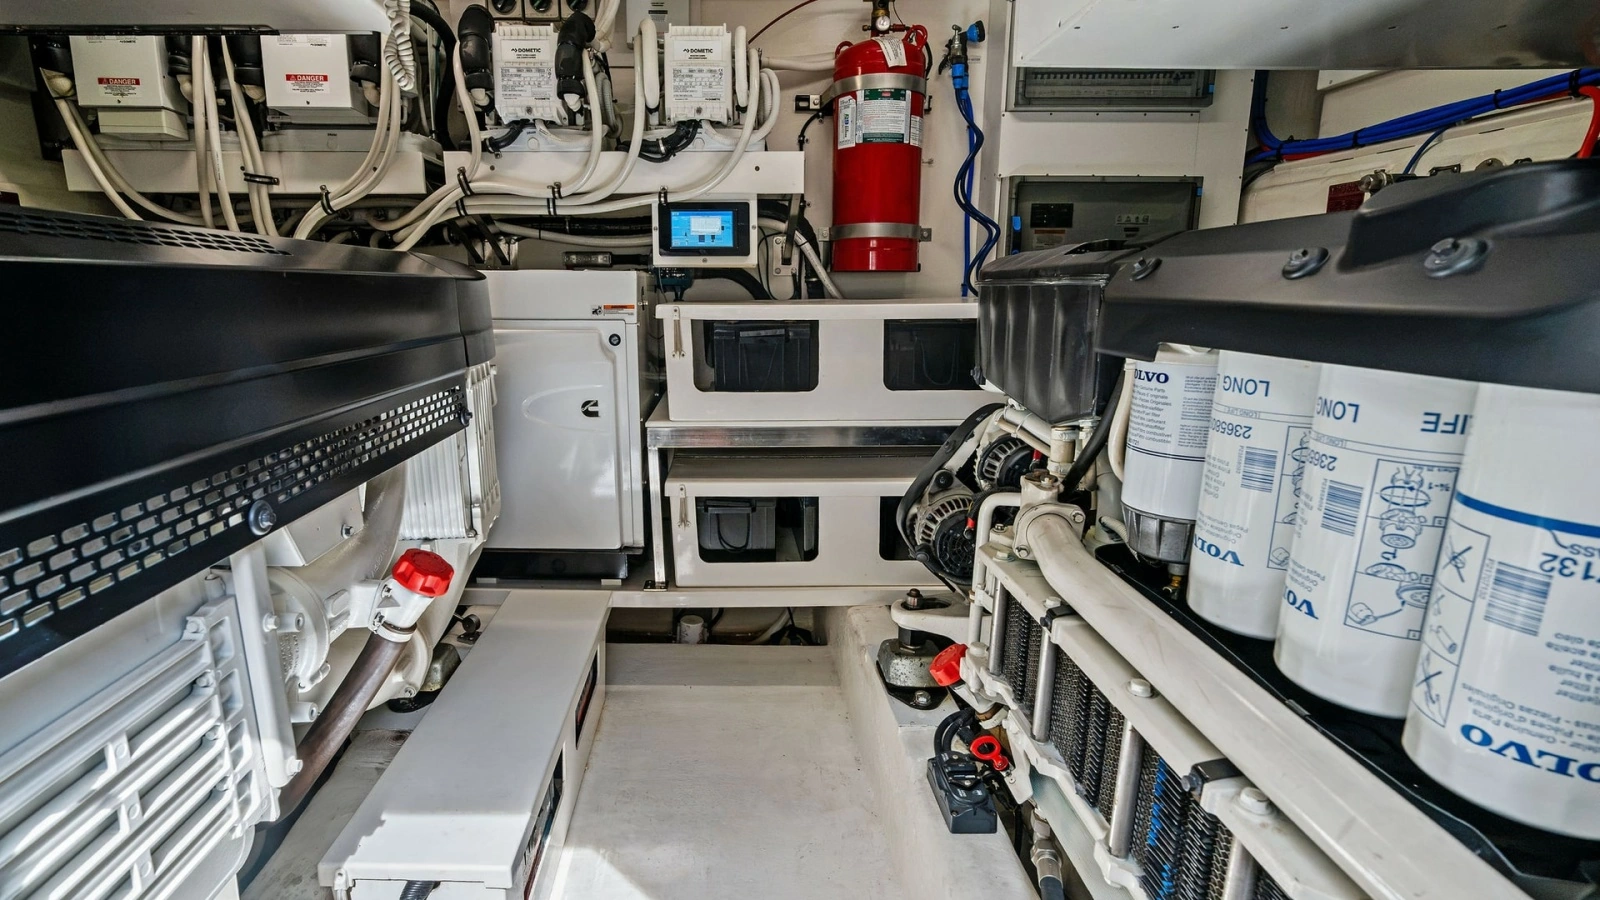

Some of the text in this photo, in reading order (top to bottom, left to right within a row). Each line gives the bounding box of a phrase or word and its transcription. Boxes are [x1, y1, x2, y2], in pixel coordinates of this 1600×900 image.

[1134, 368, 1169, 384] OLVO
[1223, 375, 1270, 397] LONG
[1316, 396, 1360, 423] LONG
[1420, 412, 1472, 435] IFE
[1548, 665, 1581, 679] huile
[1461, 683, 1515, 710] Originales
[1472, 709, 1501, 726] Parts
[1518, 705, 1561, 724] Piezas
[1504, 722, 1556, 744] Genuine
[1530, 720, 1574, 739] Pièces
[1460, 724, 1600, 784] OLVO
